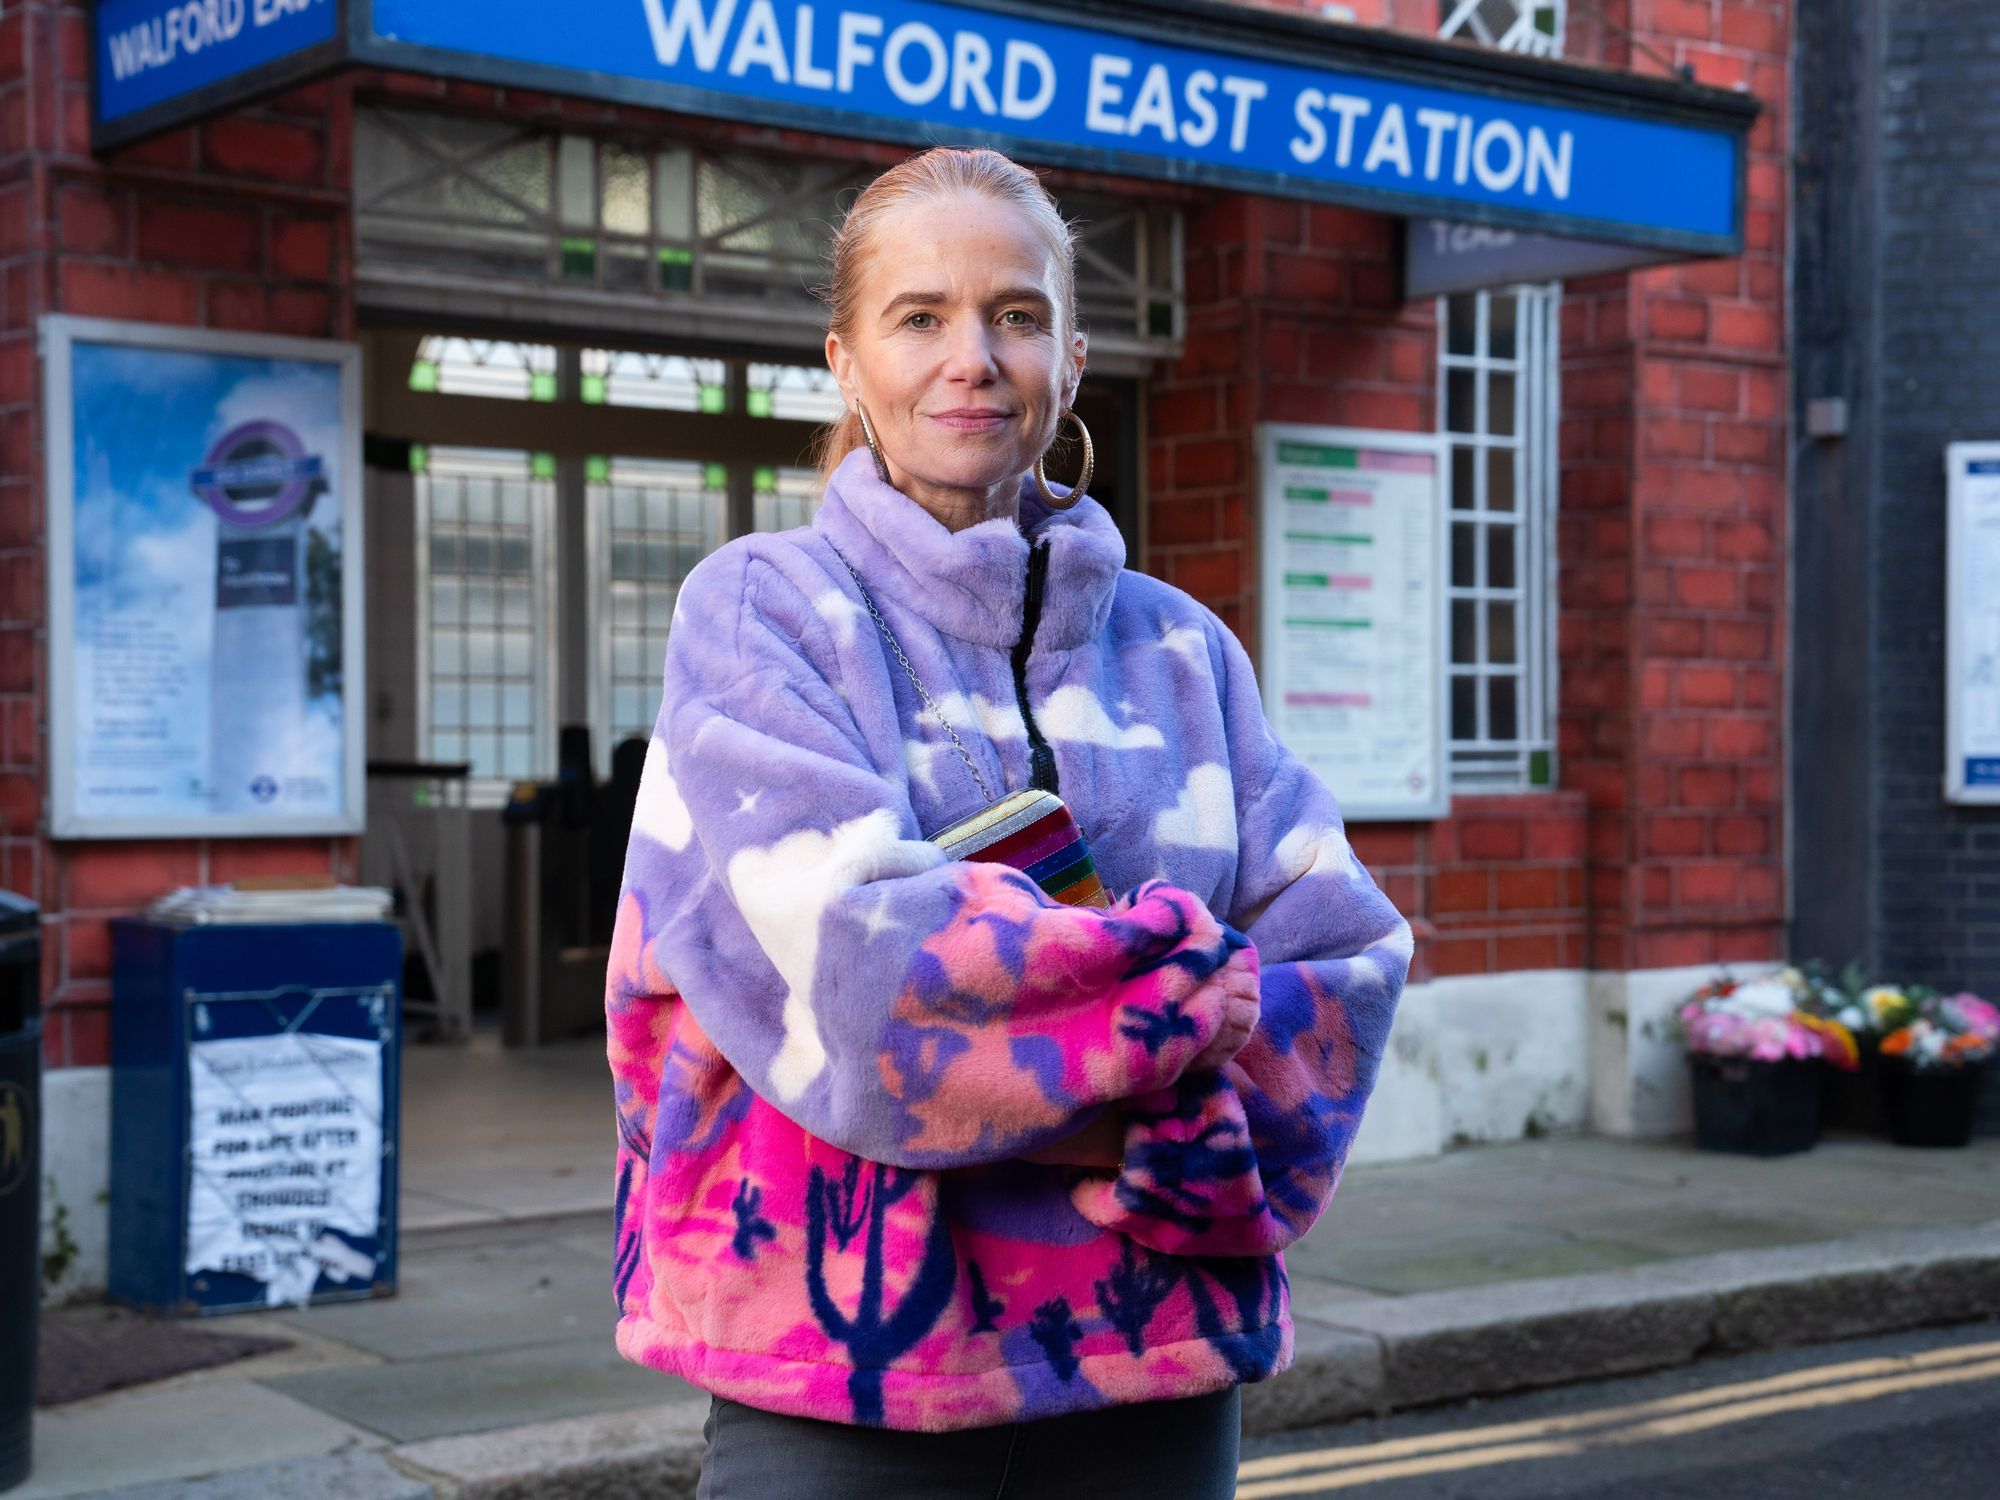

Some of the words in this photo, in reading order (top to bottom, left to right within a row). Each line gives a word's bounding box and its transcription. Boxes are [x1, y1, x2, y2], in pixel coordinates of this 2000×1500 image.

[108, 0, 245, 81] WALFORD
[642, 0, 1057, 121] WALFORD
[1085, 53, 1268, 152] EAST
[1289, 88, 1574, 200] STATION
